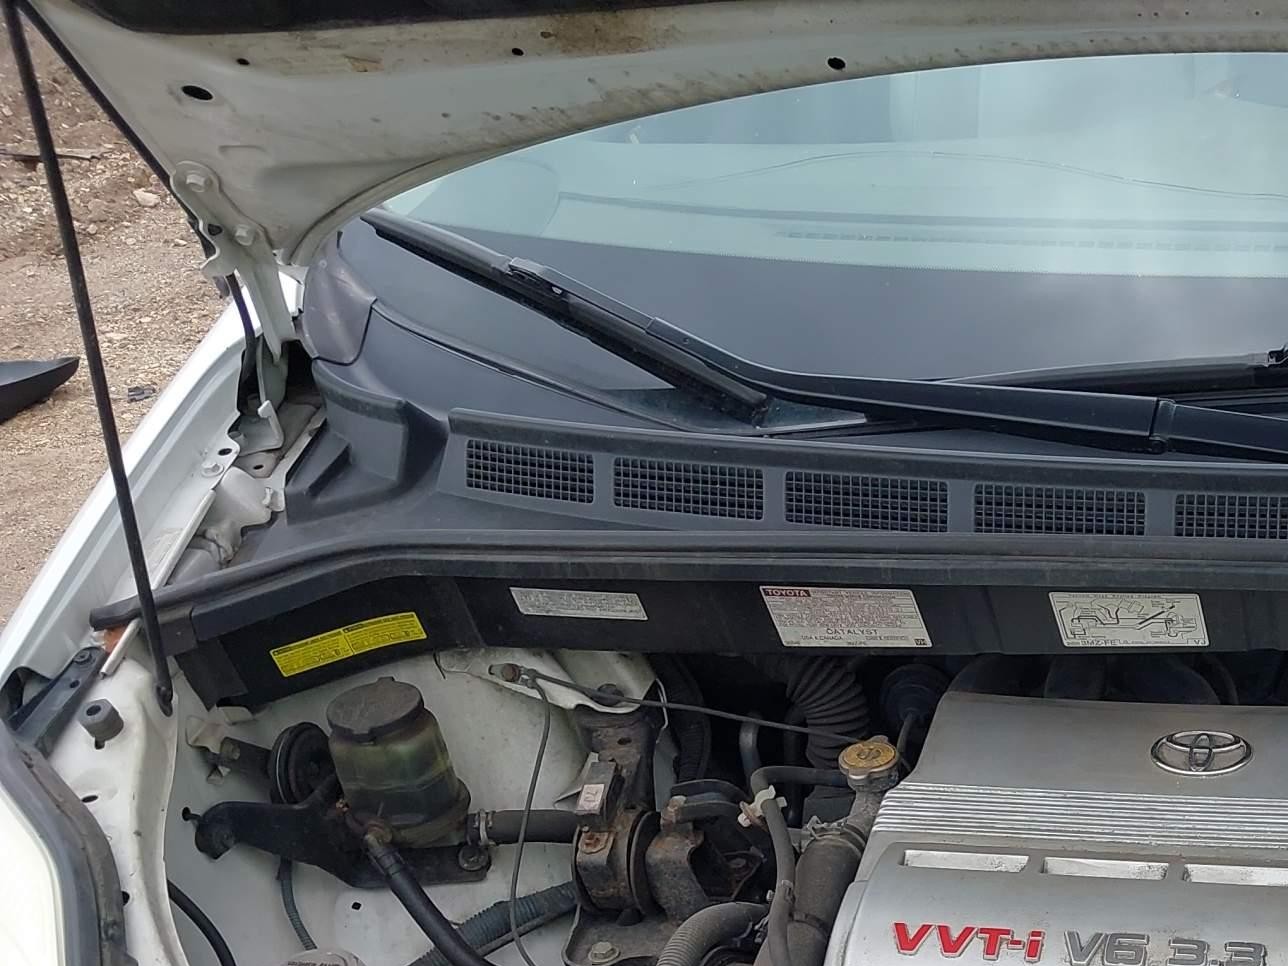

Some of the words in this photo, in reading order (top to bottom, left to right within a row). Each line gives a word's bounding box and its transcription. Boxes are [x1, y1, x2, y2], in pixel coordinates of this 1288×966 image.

[765, 588, 808, 598] TOYOTA
[826, 628, 879, 636] CATALYST
[893, 922, 1045, 963] VVT-i
